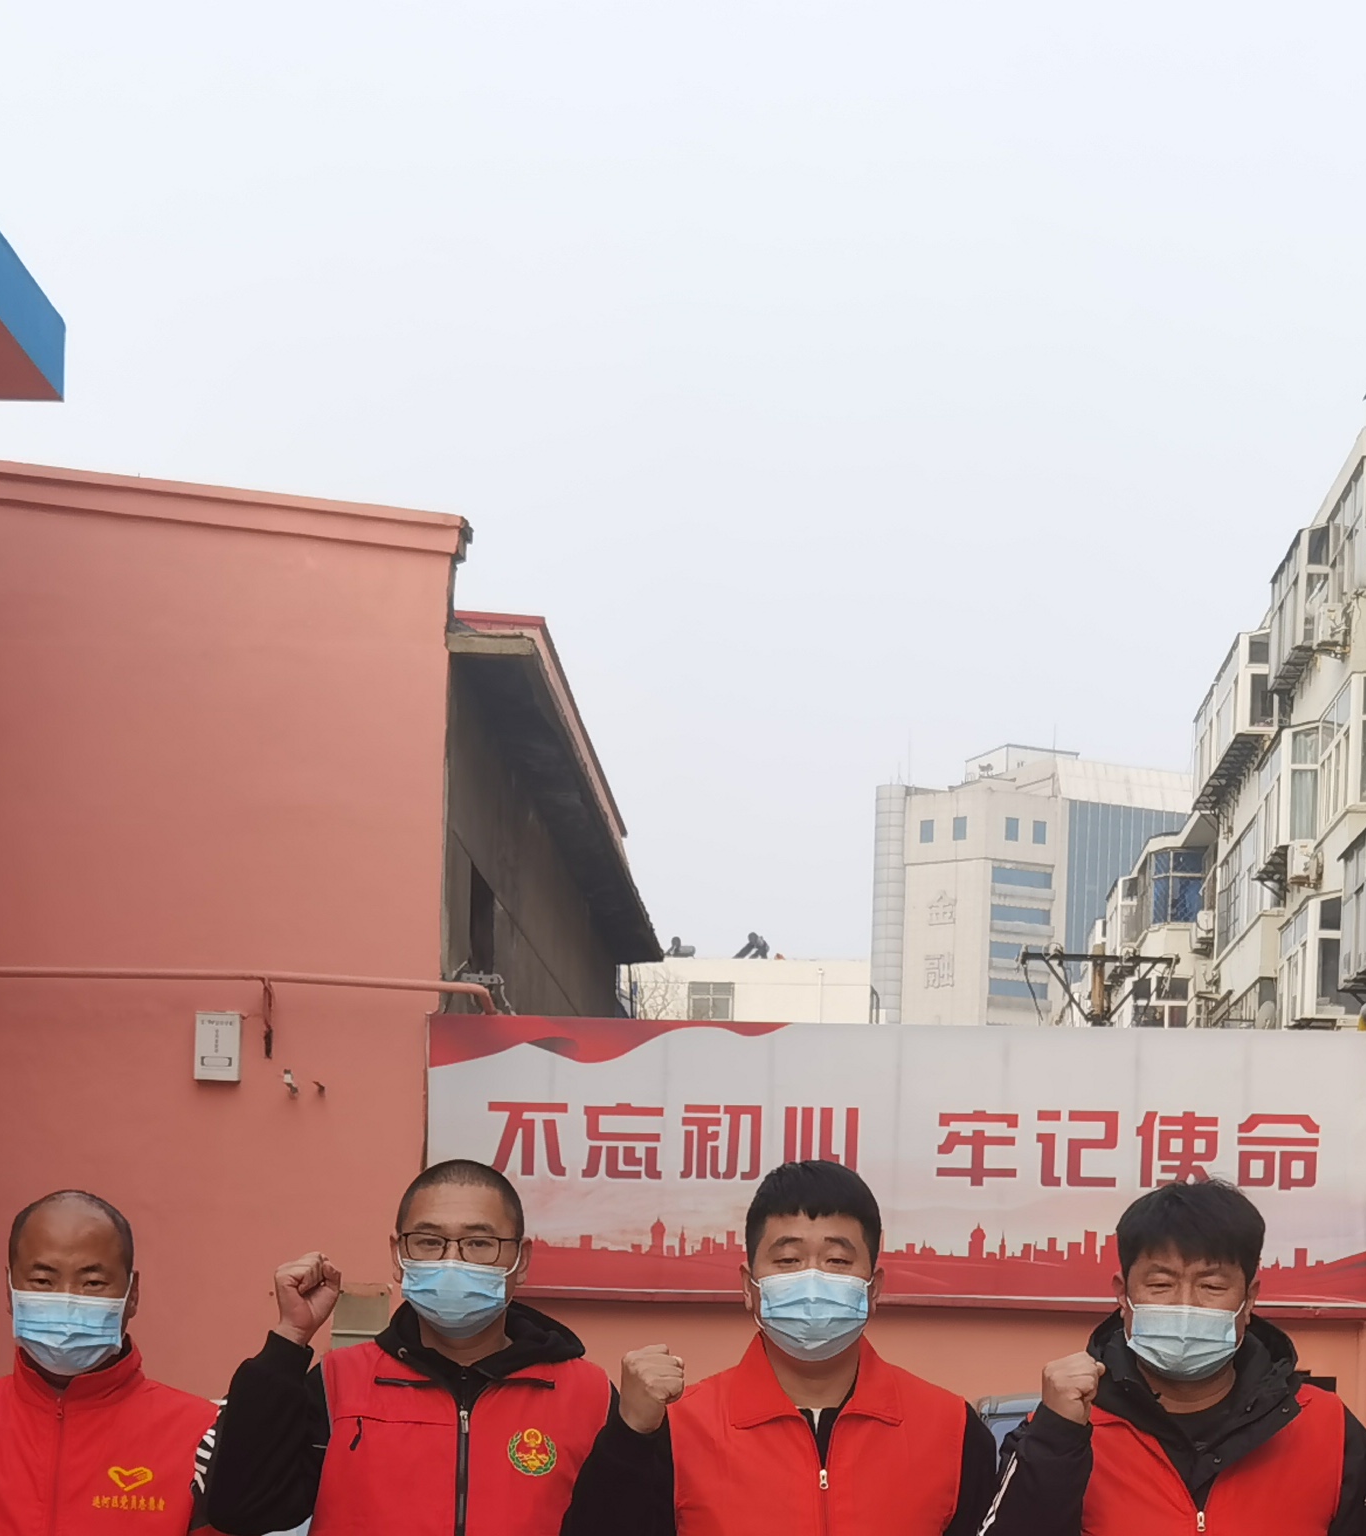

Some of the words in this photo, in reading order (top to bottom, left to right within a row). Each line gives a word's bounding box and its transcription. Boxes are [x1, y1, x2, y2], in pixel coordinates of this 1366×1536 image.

[487, 1101, 859, 1179] 不忘初心
[936, 1110, 1320, 1191] 牢记使命
